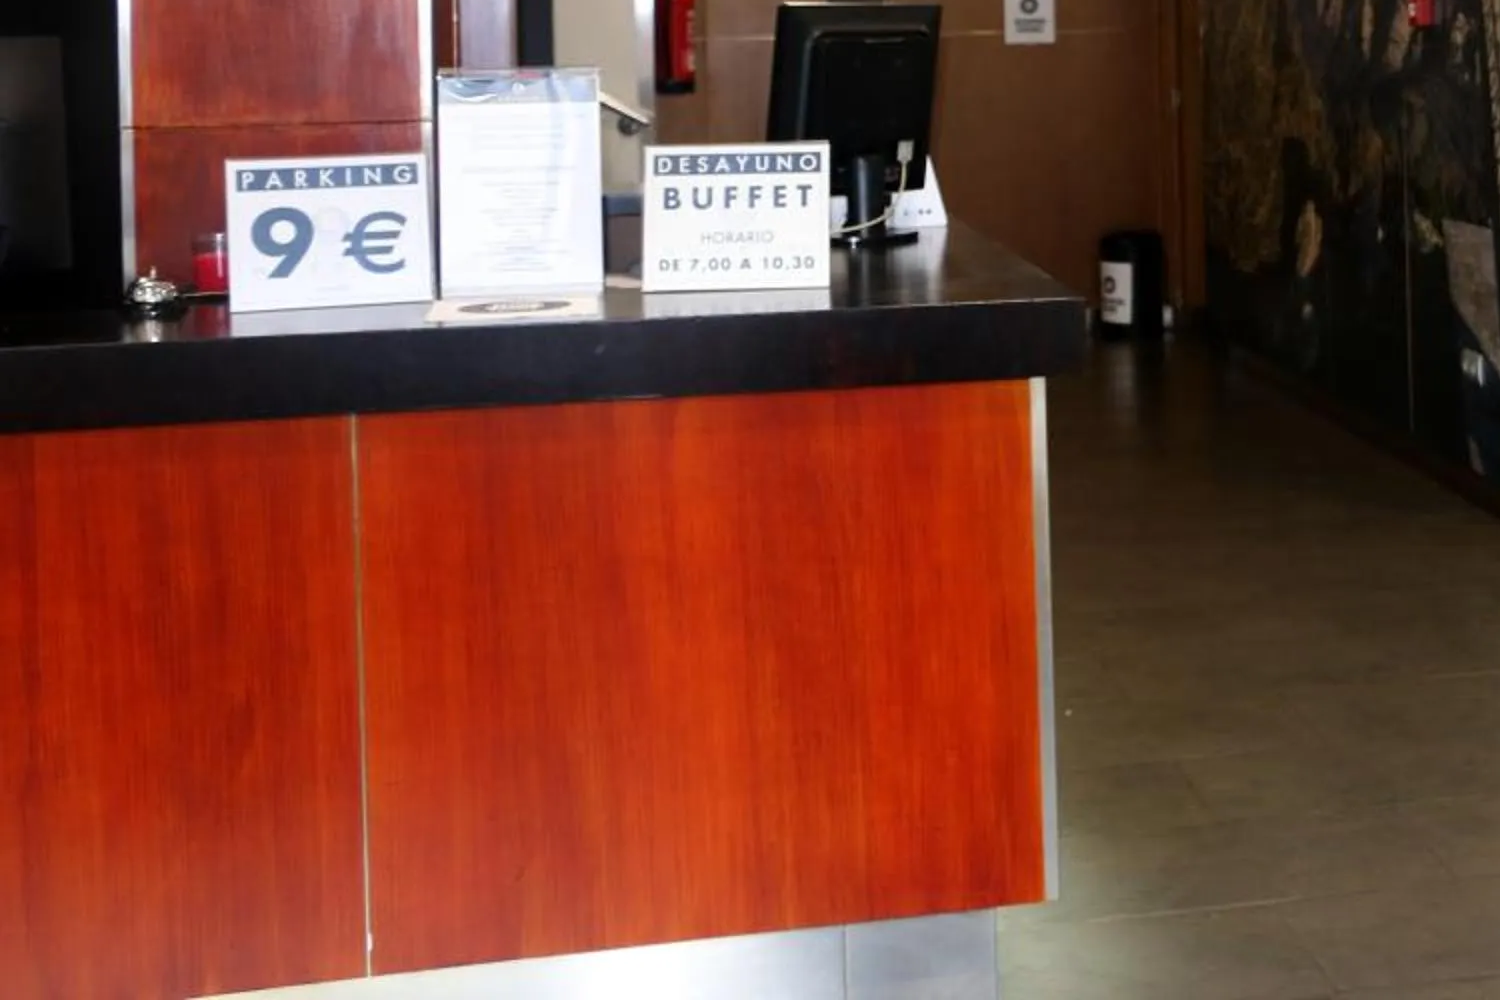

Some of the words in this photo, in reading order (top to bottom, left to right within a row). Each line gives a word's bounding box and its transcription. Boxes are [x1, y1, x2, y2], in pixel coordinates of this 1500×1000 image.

[657, 154, 817, 174] DESAYUNO
[241, 165, 413, 190] PARKING
[663, 184, 813, 211] BUFFET
[251, 206, 315, 279] 9
[341, 210, 407, 274] €
[701, 230, 775, 245] HORARIO
[659, 258, 680, 272] DE
[740, 258, 752, 270] A
